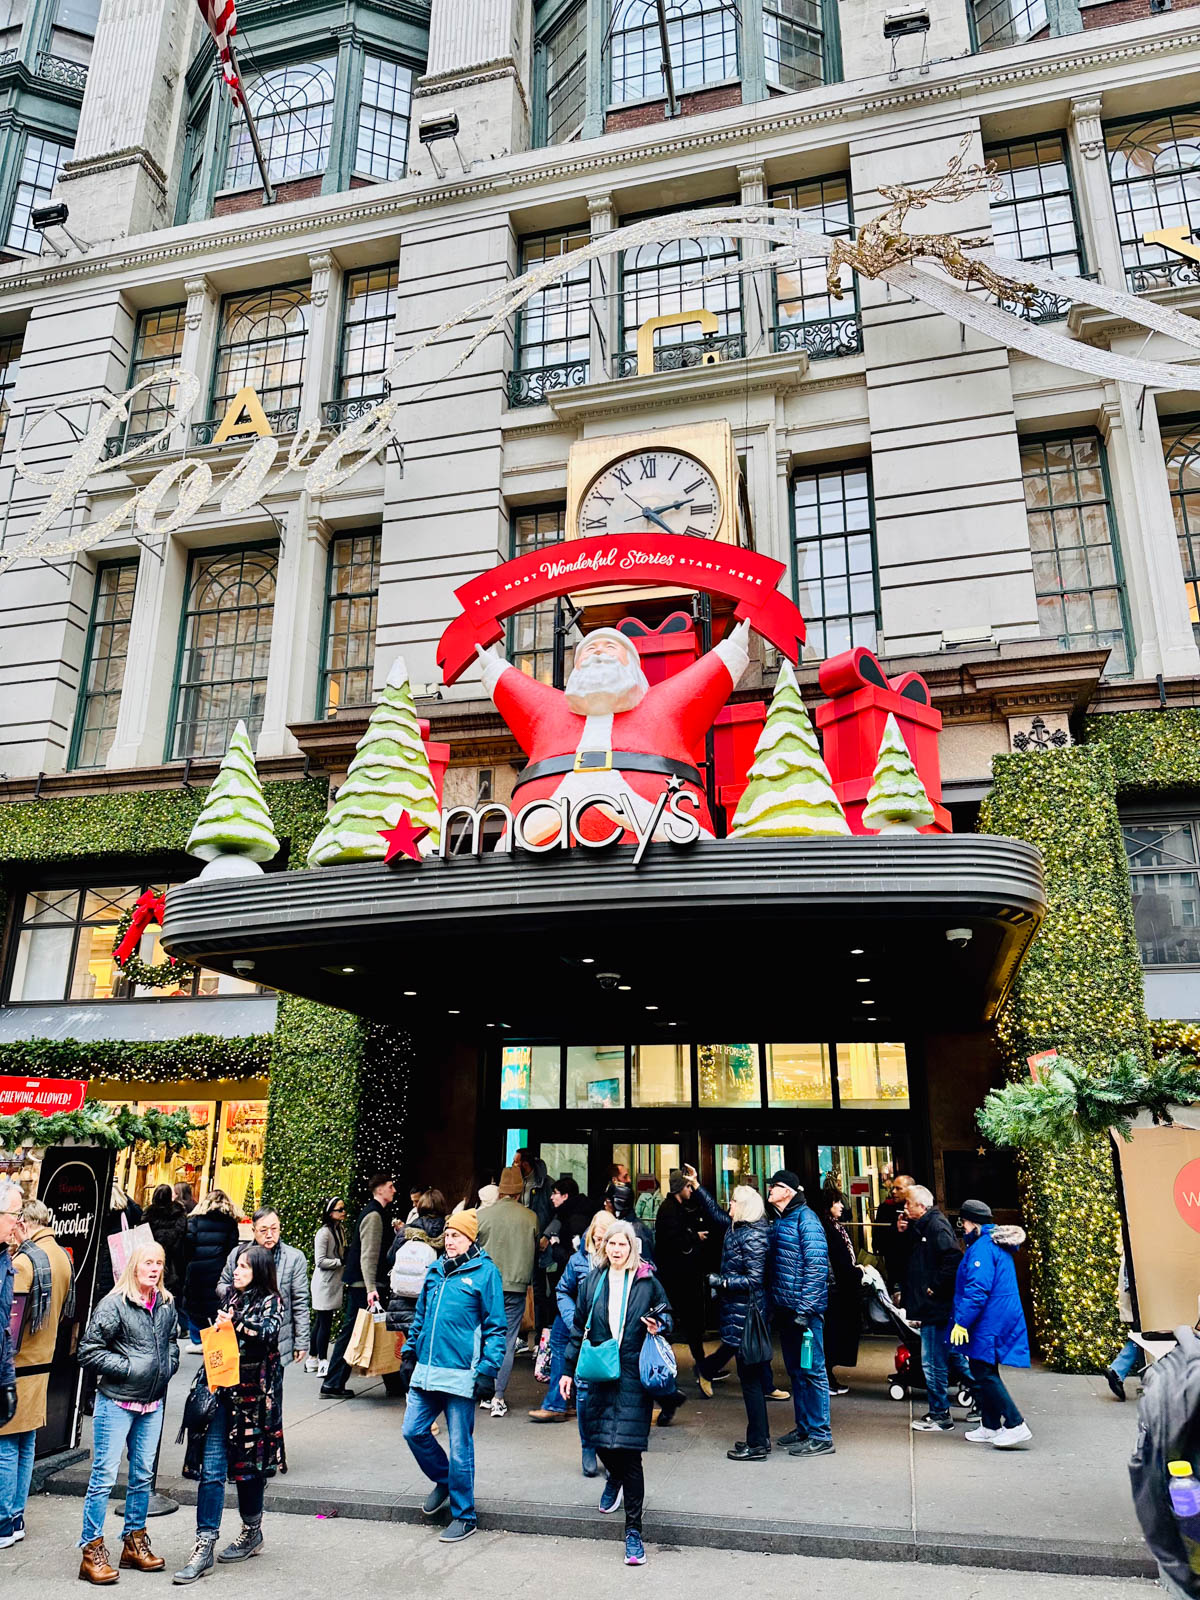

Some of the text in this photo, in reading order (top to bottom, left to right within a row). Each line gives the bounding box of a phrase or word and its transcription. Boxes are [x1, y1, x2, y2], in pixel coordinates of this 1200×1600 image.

[475, 547, 763, 606] THE MOST Wonderful Stories START HERE
[34, 1092, 72, 1105] ALLOWED!
